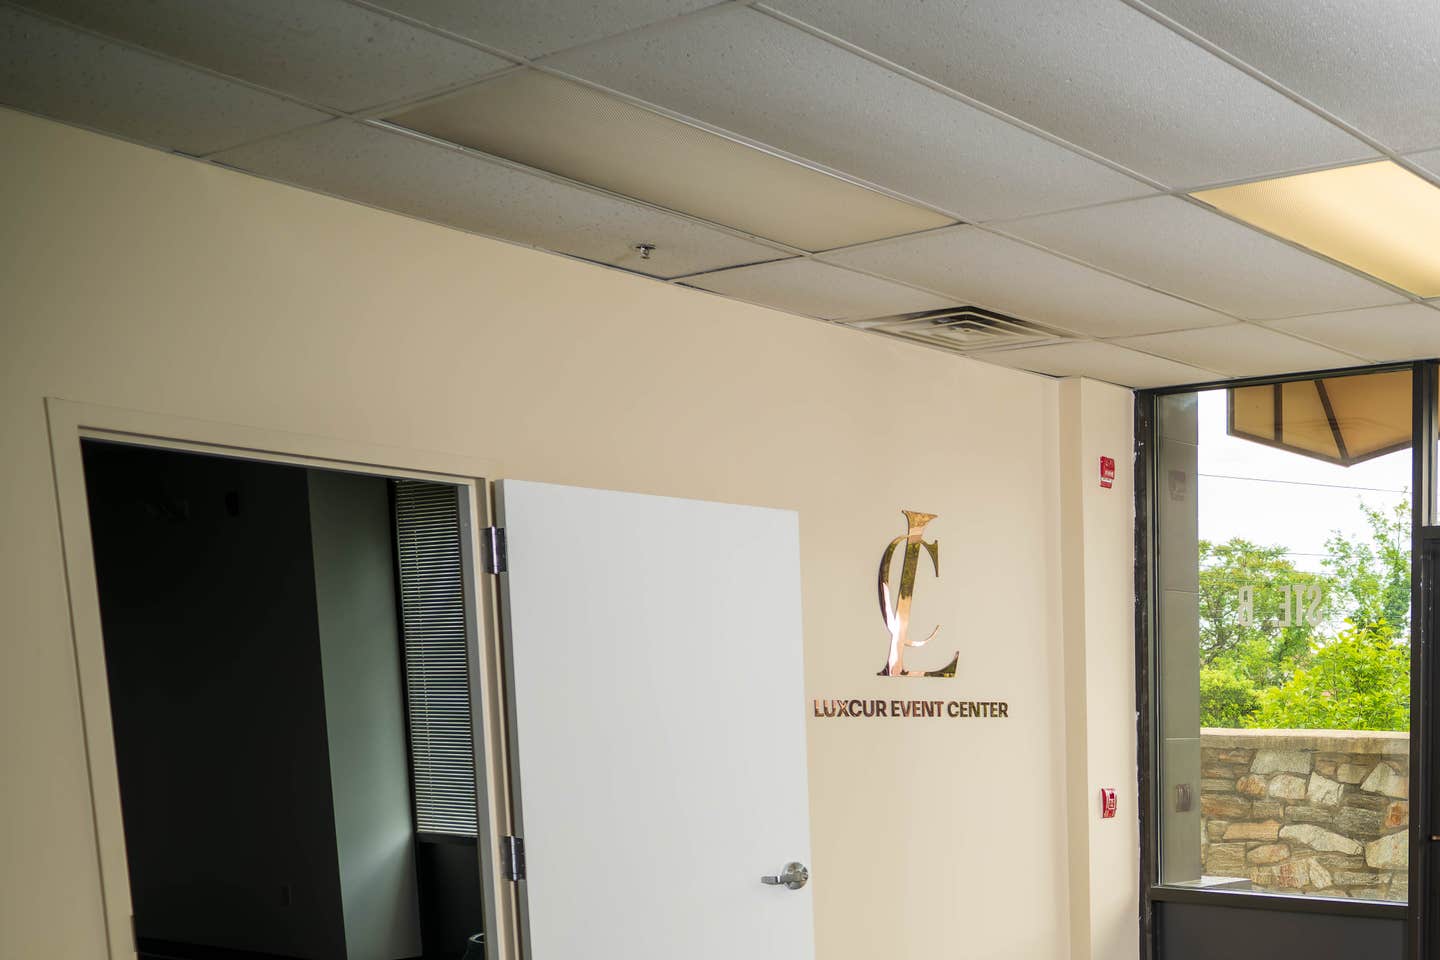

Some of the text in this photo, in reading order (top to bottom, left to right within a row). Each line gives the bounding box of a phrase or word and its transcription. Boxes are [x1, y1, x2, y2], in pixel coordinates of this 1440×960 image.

[813, 699, 1009, 718] LUXCUR EVENT CENTER
